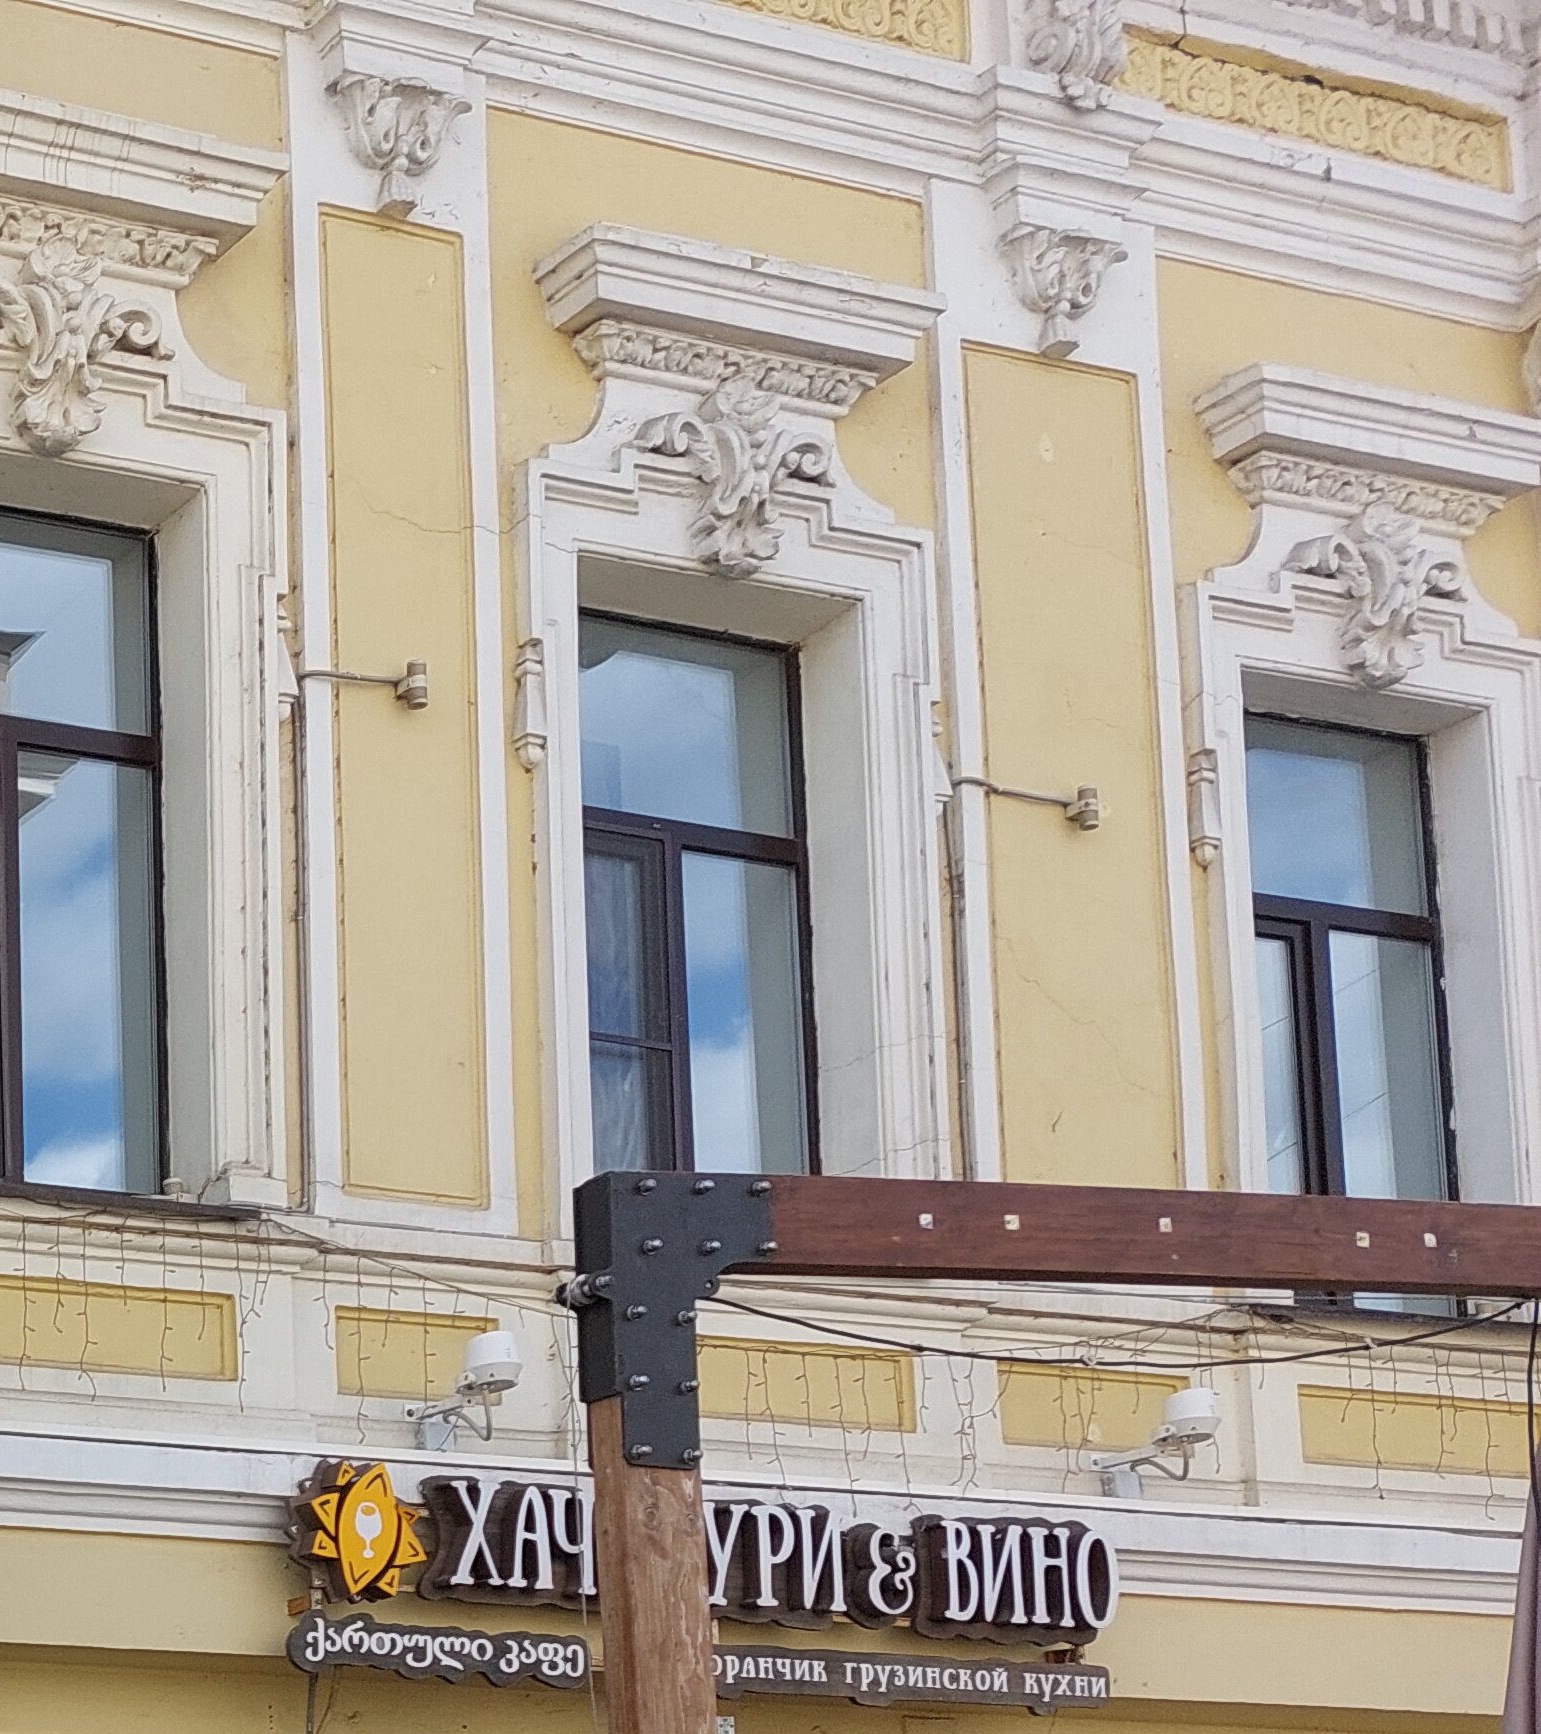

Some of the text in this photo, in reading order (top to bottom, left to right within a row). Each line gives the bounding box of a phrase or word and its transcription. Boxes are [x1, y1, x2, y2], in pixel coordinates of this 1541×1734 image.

[448, 1480, 1117, 1631] ХАЧУРИ & ВИНО
[304, 1618, 585, 1678] ქართული კაფე
